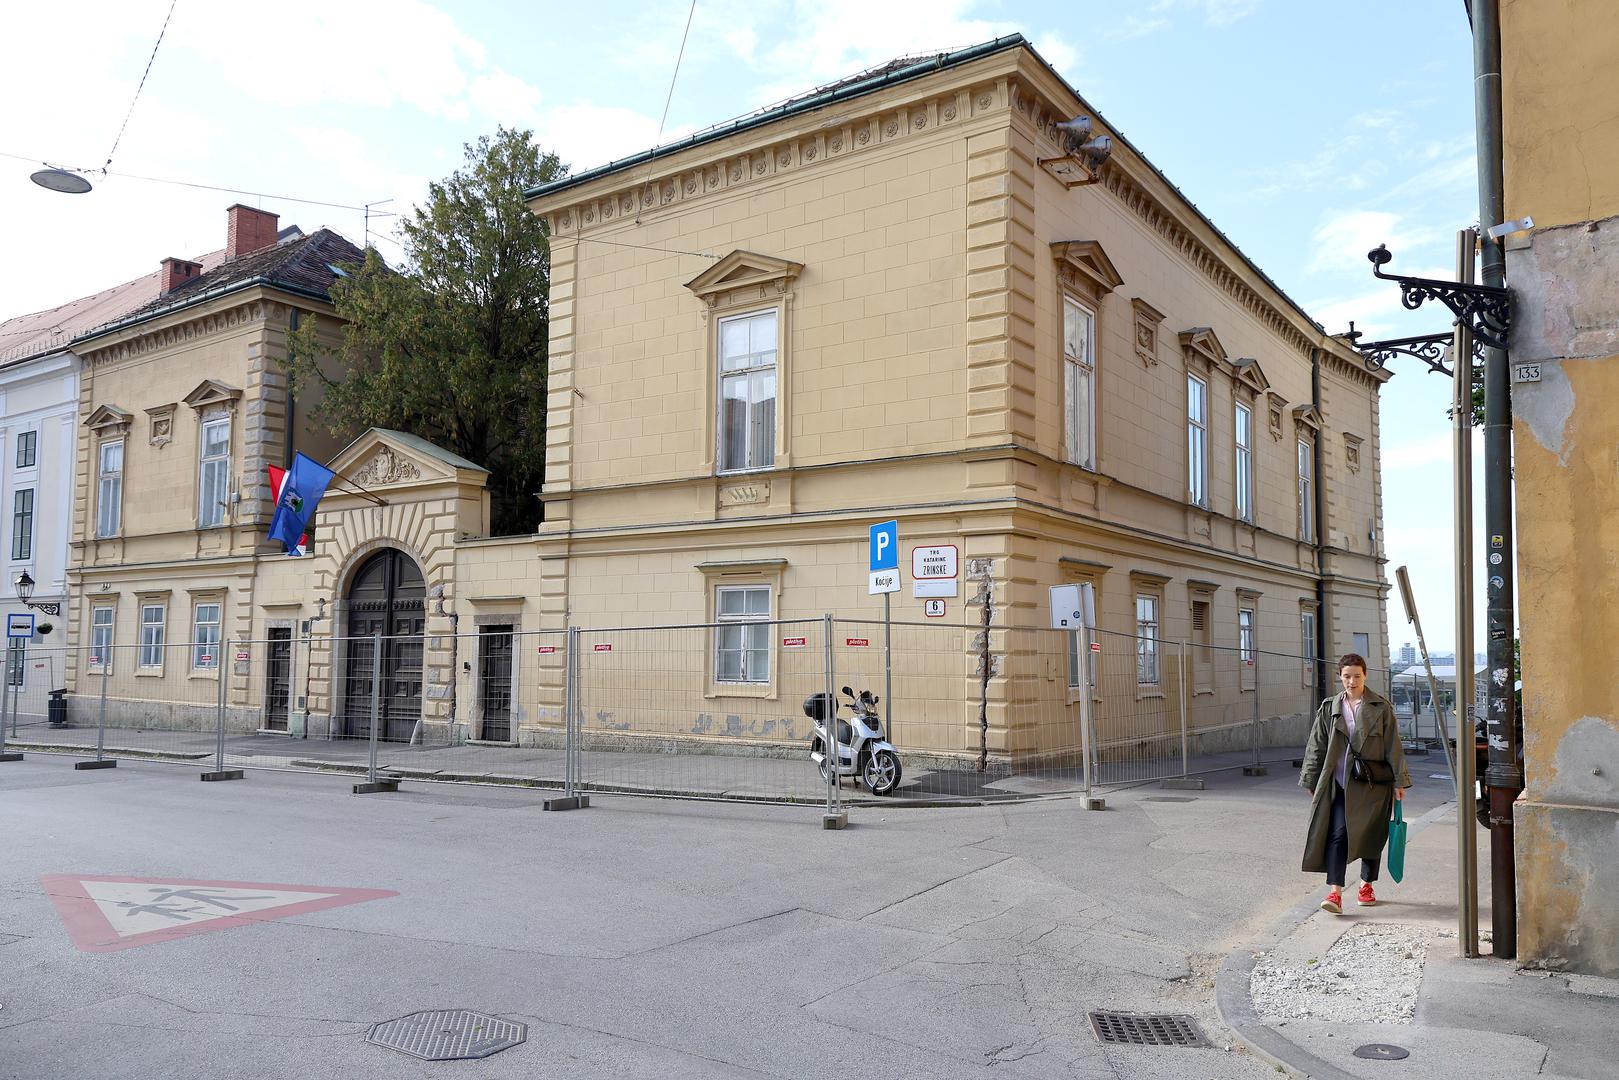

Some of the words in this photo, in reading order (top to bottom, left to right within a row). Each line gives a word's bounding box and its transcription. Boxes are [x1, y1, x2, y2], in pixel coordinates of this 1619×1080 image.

[1515, 366, 1540, 379] 133
[877, 532, 889, 561] P
[923, 565, 947, 576] ZRINSKE
[932, 600, 939, 611] 6
